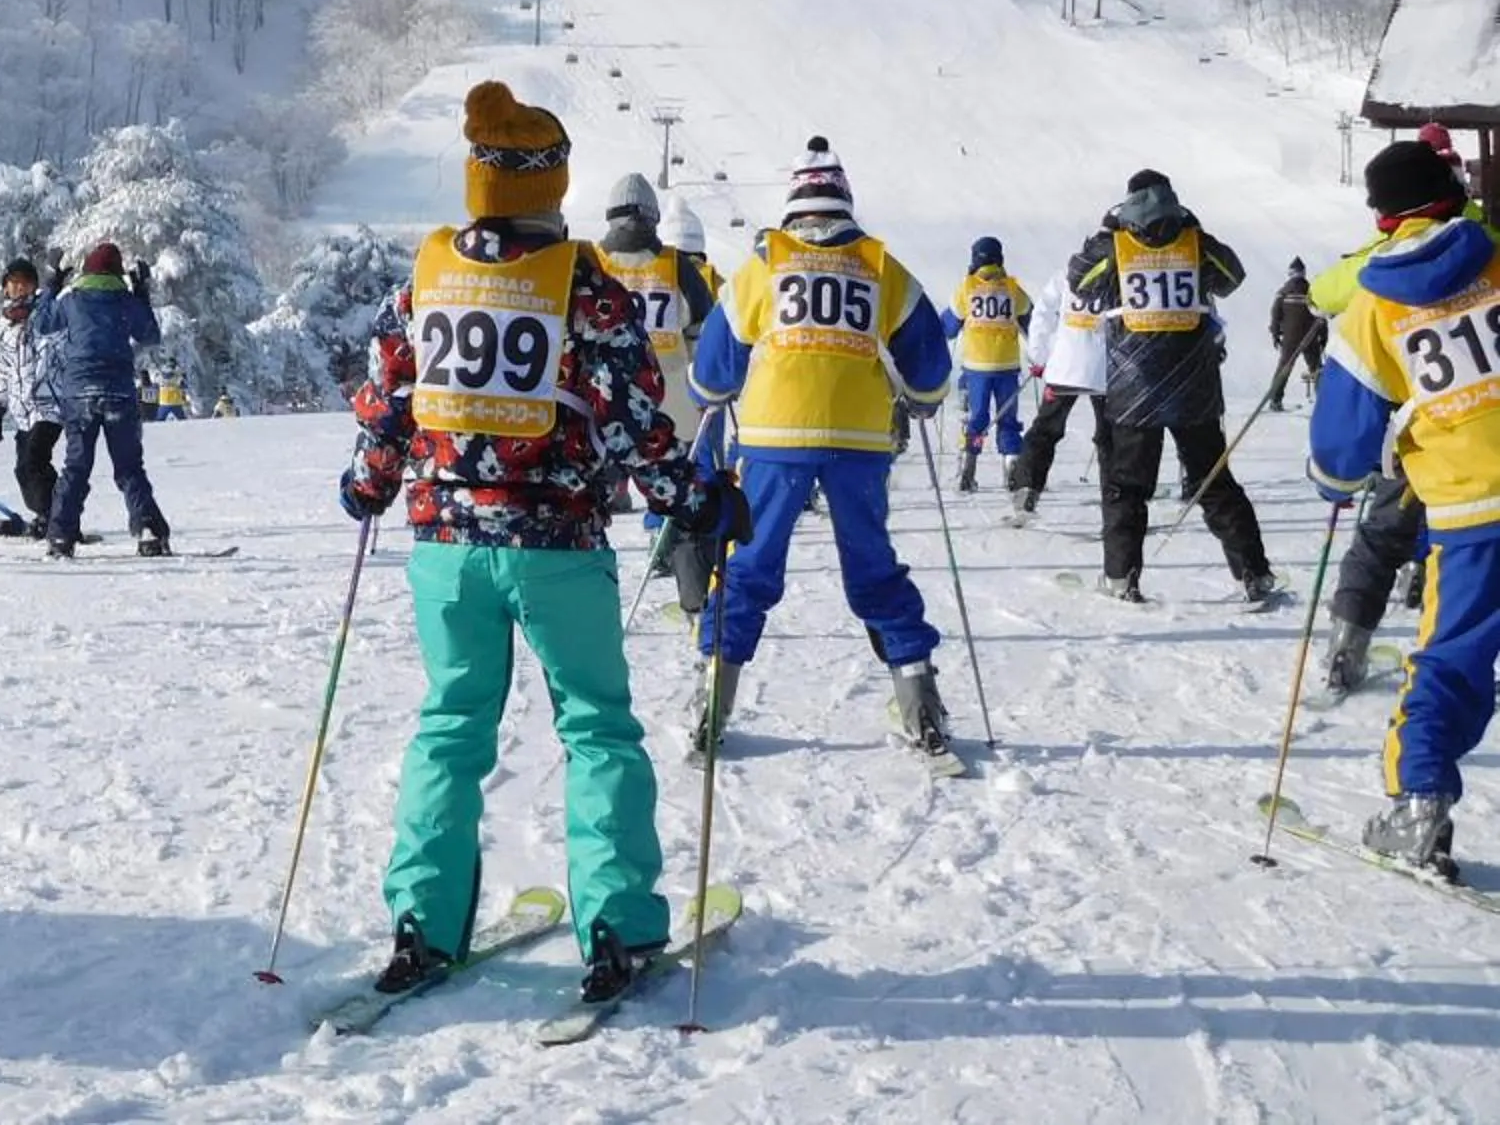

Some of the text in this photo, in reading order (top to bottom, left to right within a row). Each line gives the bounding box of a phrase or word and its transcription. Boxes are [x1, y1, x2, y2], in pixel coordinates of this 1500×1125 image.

[779, 275, 871, 331] 305
[971, 296, 1012, 319] 304
[1126, 271, 1195, 309] 315
[421, 310, 549, 392] 299
